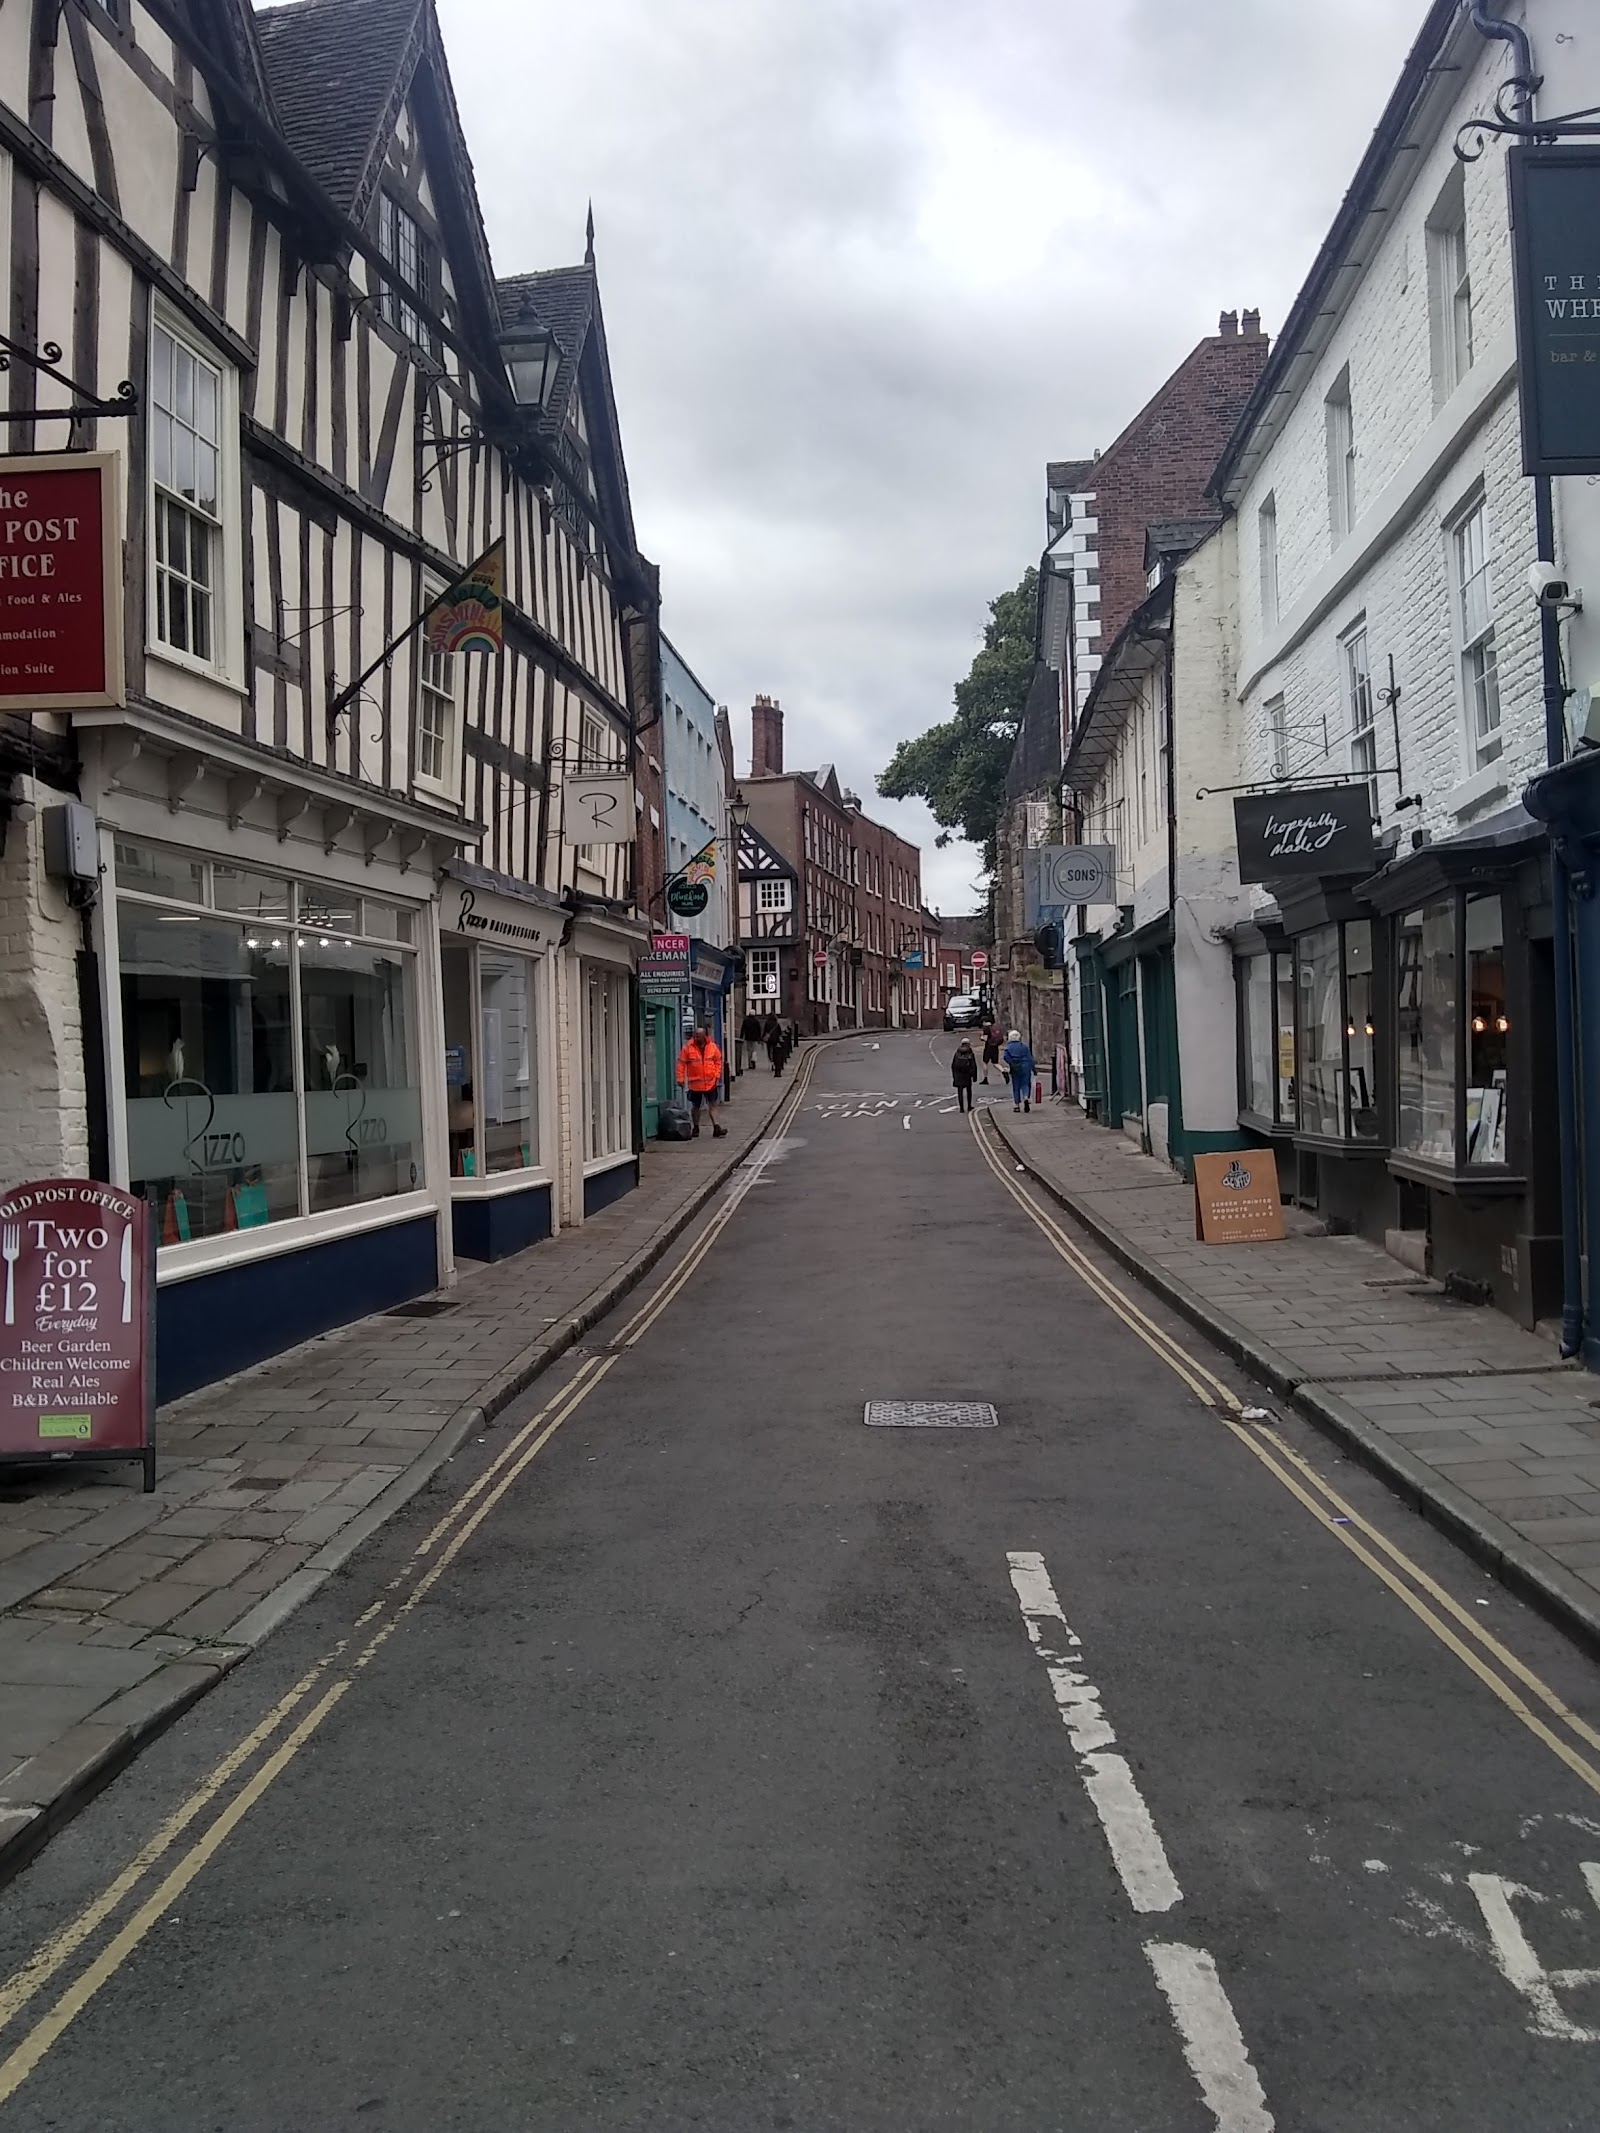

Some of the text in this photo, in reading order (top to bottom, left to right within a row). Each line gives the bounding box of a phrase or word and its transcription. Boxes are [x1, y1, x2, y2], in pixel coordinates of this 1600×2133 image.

[1550, 350, 1577, 363] bar
[0, 486, 28, 508] he
[5, 517, 80, 543] POST
[0, 553, 56, 578] FICE
[7, 591, 82, 605] Food & Ales
[0, 627, 56, 640] modation
[24, 662, 55, 674] Suite
[578, 792, 618, 829] R
[1264, 812, 1347, 848] hopefully
[1067, 869, 1096, 882] SONS
[653, 940, 685, 949] NCER
[0, 1187, 136, 1220] OLD POST OFFICE
[27, 1220, 109, 1249] Two
[42, 1251, 93, 1279] for
[35, 1281, 98, 1312] £12
[35, 1314, 98, 1334] Everyday
[20, 1339, 111, 1353] Beer Garden
[0, 1357, 131, 1371] Children Welcome
[31, 1374, 101, 1388] Real Ales
[12, 1391, 119, 1407] B&B Available
